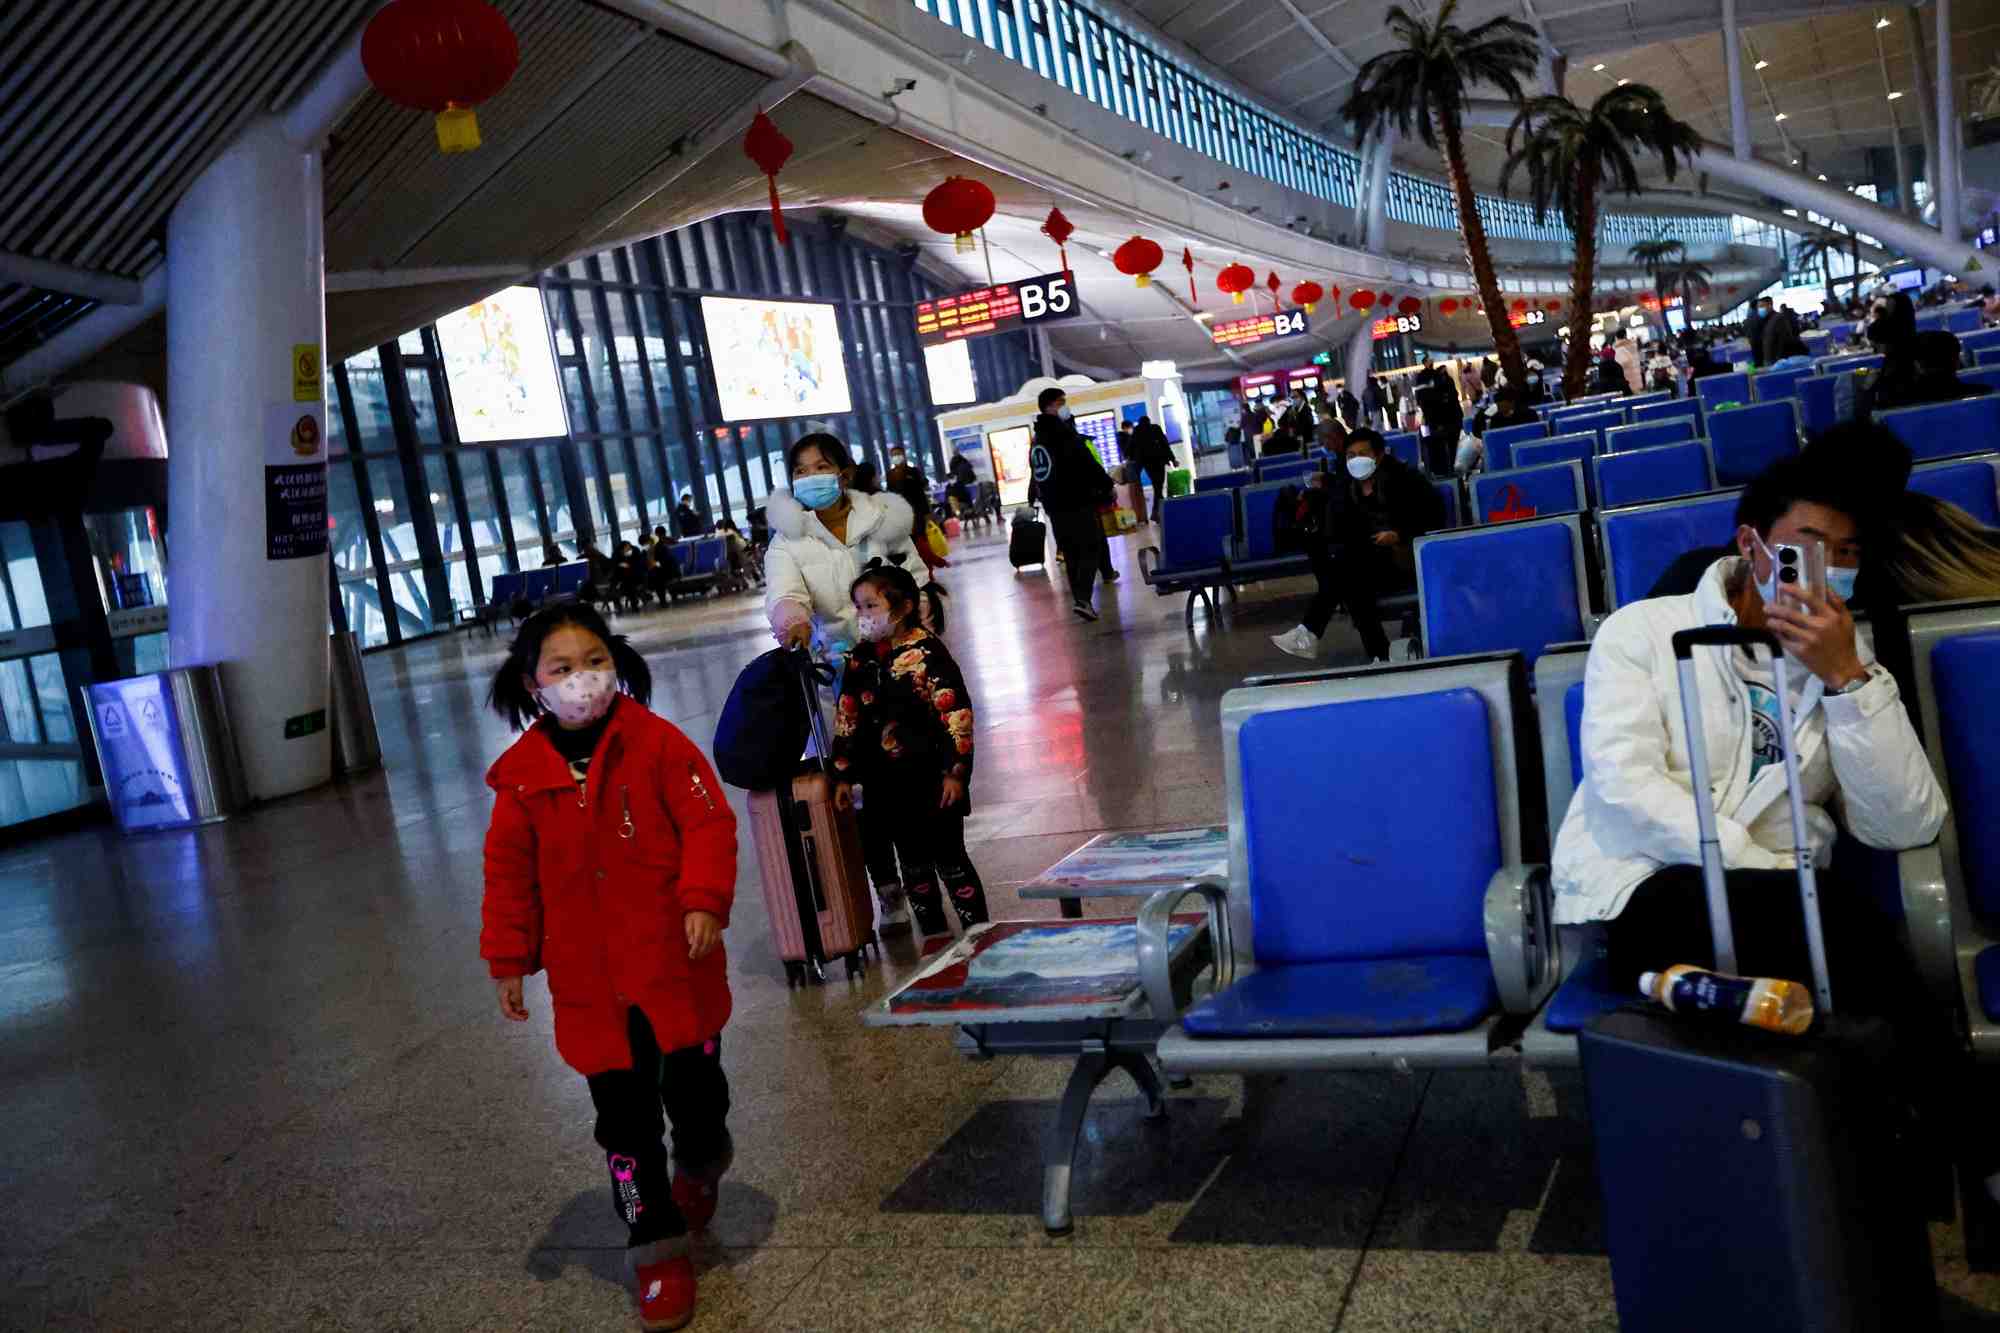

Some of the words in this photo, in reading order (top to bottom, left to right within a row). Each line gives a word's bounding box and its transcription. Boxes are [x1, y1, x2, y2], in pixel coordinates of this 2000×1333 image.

[1020, 279, 1071, 319] B5
[1275, 312, 1305, 335] B4
[1397, 315, 1421, 333] B3
